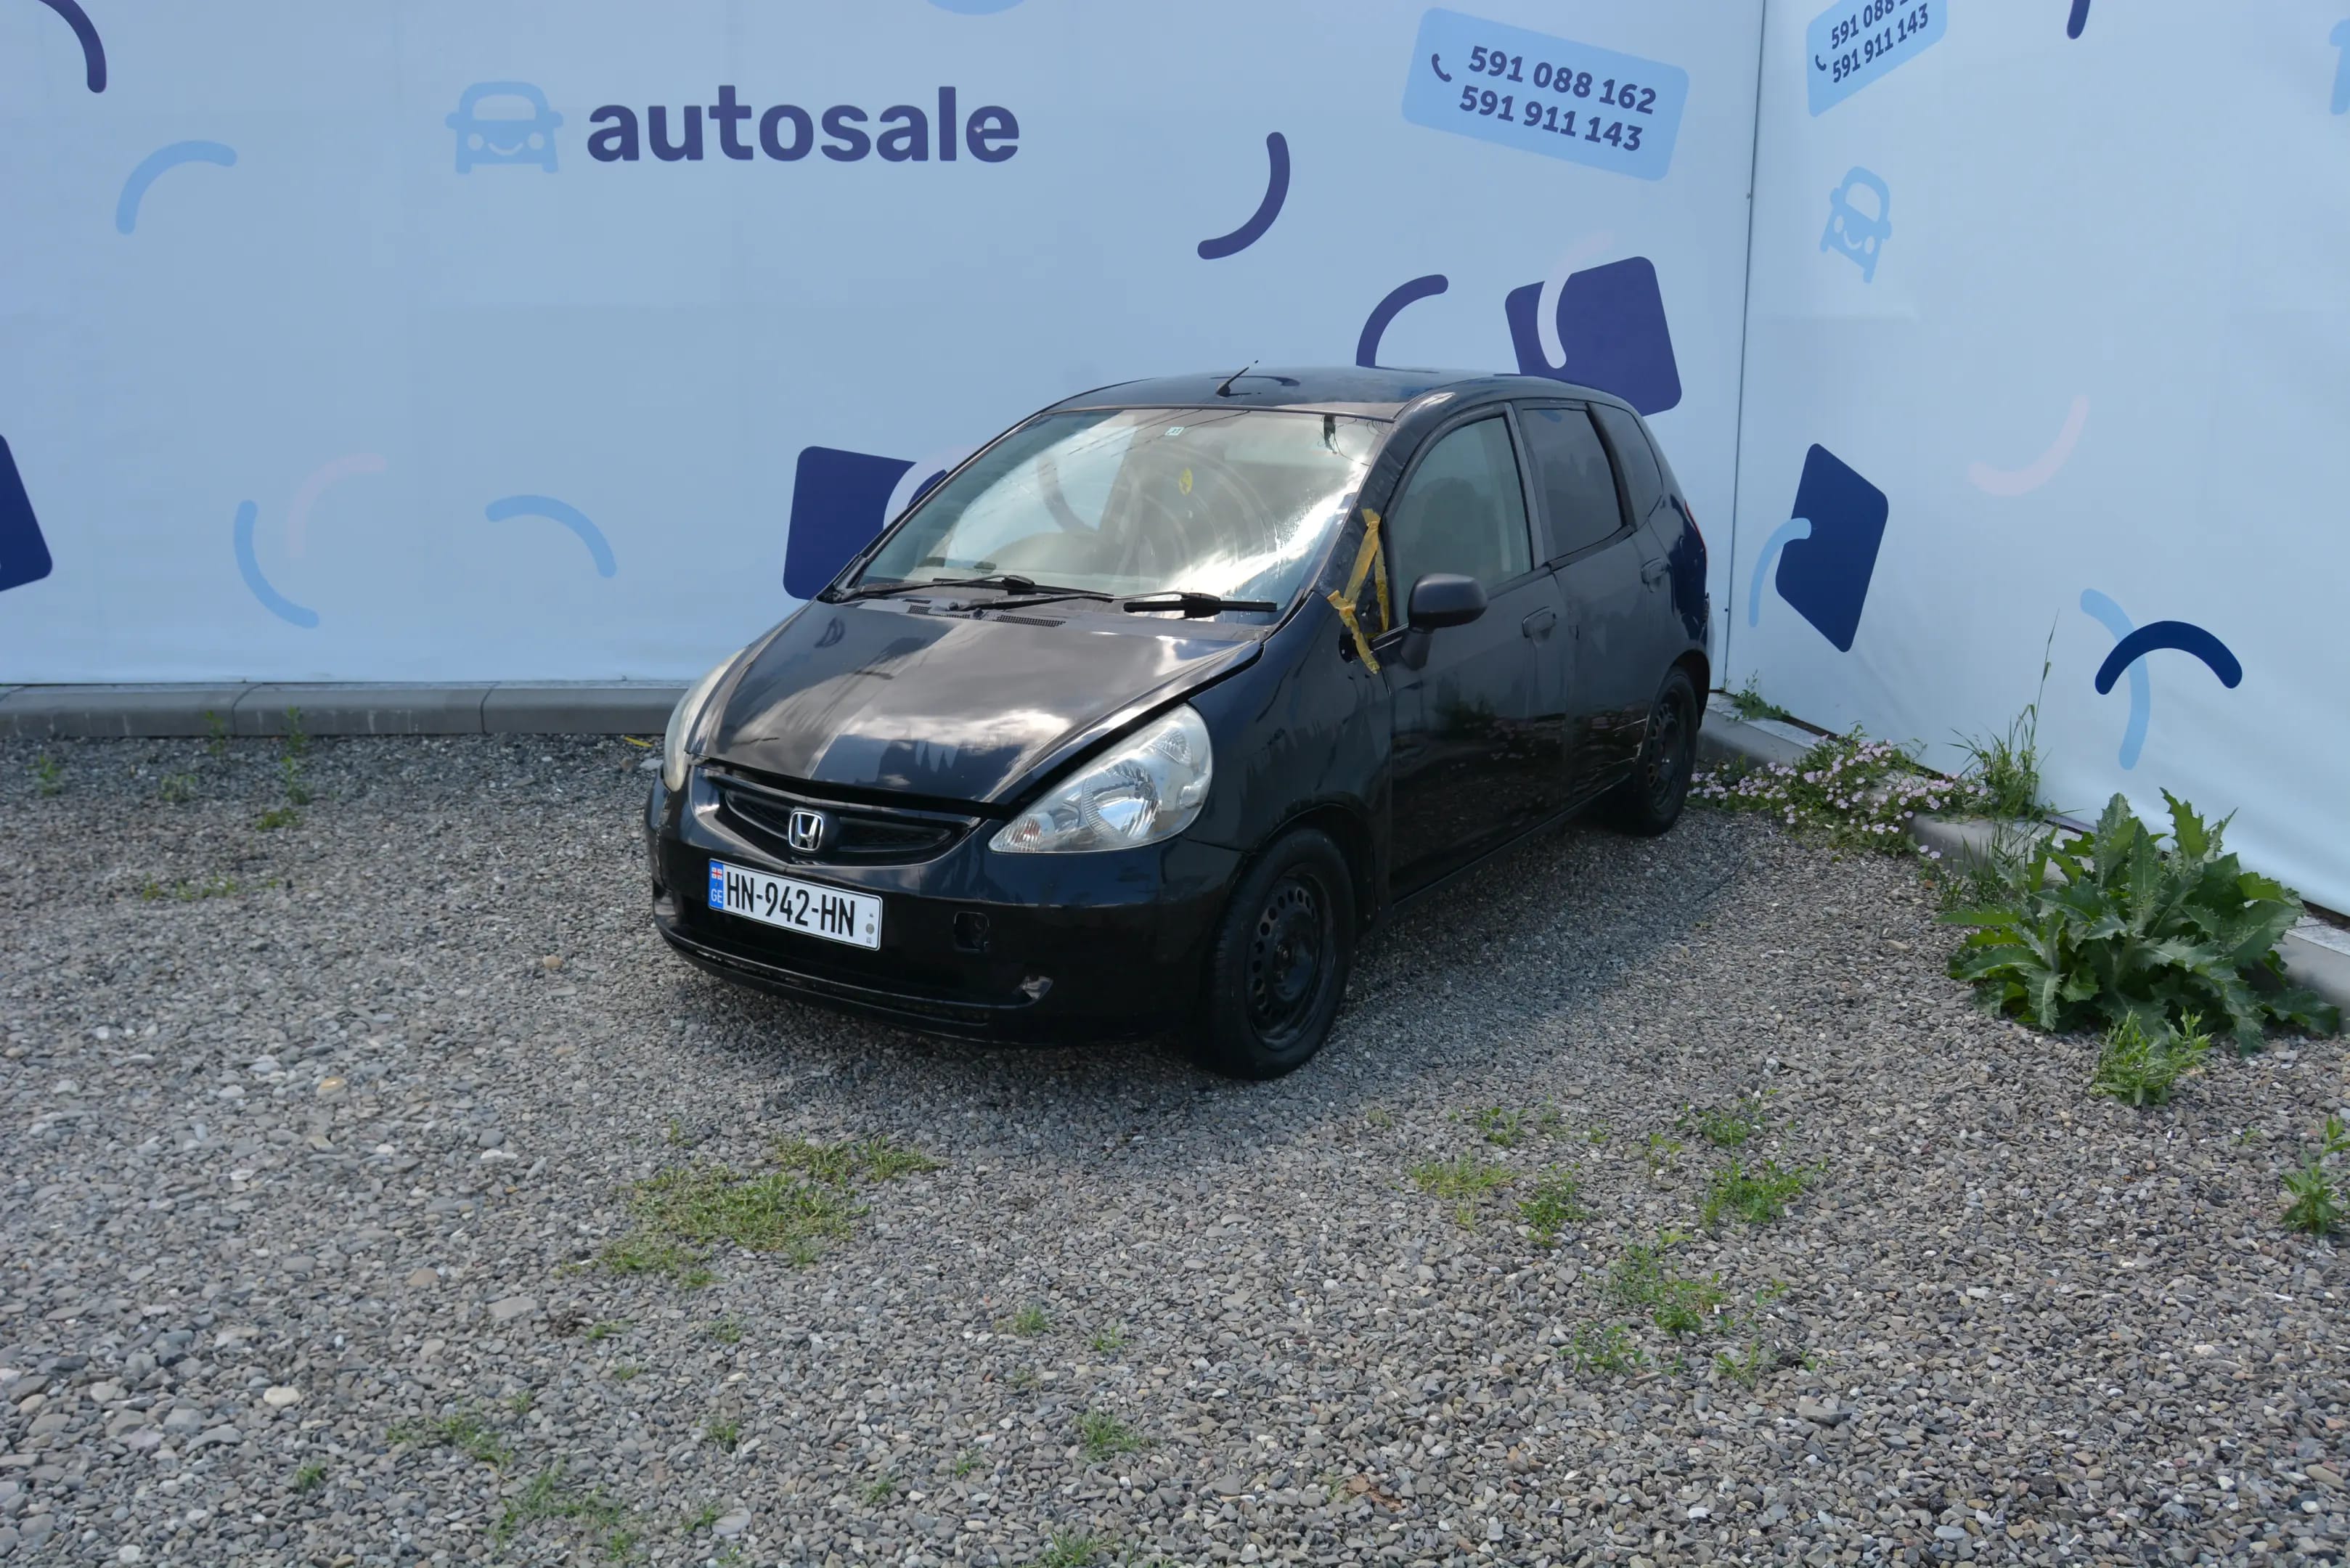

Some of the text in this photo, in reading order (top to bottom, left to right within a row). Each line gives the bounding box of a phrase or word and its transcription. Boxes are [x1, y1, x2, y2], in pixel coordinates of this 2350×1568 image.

[1832, 14, 1859, 49] 591
[1832, 3, 1929, 83] 591 911 143
[1468, 45, 1657, 115] 591 088 162
[587, 84, 1020, 163] autosale
[1458, 85, 1644, 152] 591 911 143
[710, 888, 723, 904] GE
[726, 871, 855, 937] HN-942-HN
